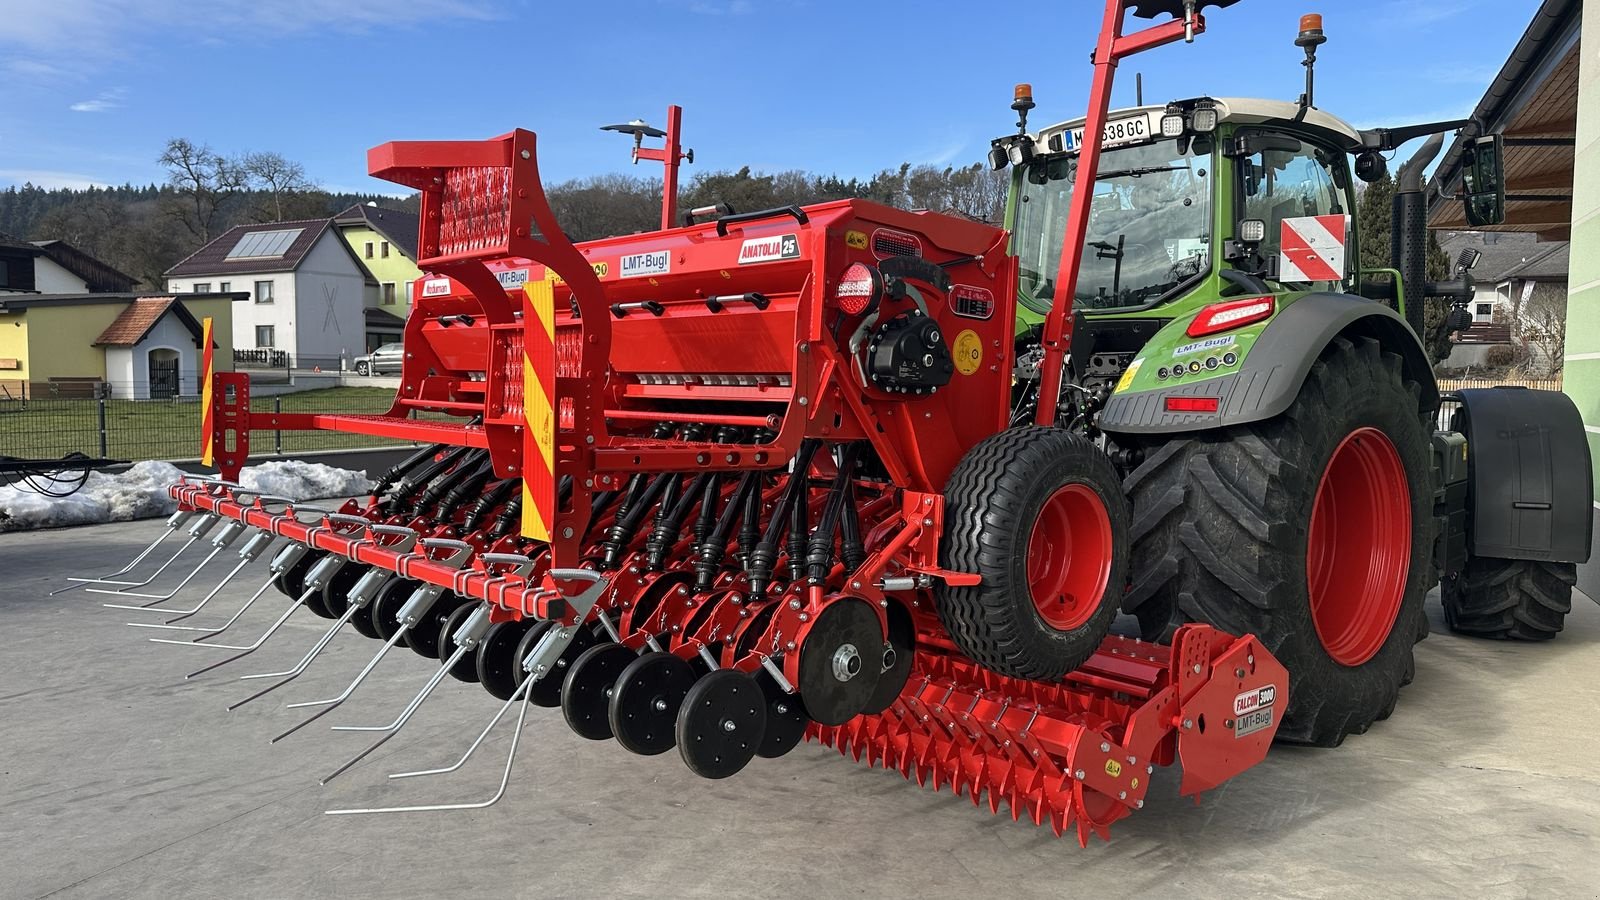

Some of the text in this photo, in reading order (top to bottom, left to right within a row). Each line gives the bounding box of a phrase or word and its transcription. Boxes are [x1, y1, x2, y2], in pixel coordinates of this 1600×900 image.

[1126, 120, 1144, 137] GC
[741, 239, 796, 259] ANATOLIA 25
[623, 252, 668, 270] LMT-Bugl
[496, 270, 528, 284] MT-Bugl
[1236, 688, 1274, 711] FALCON 3000
[1237, 709, 1272, 730] LMT-Bugl
